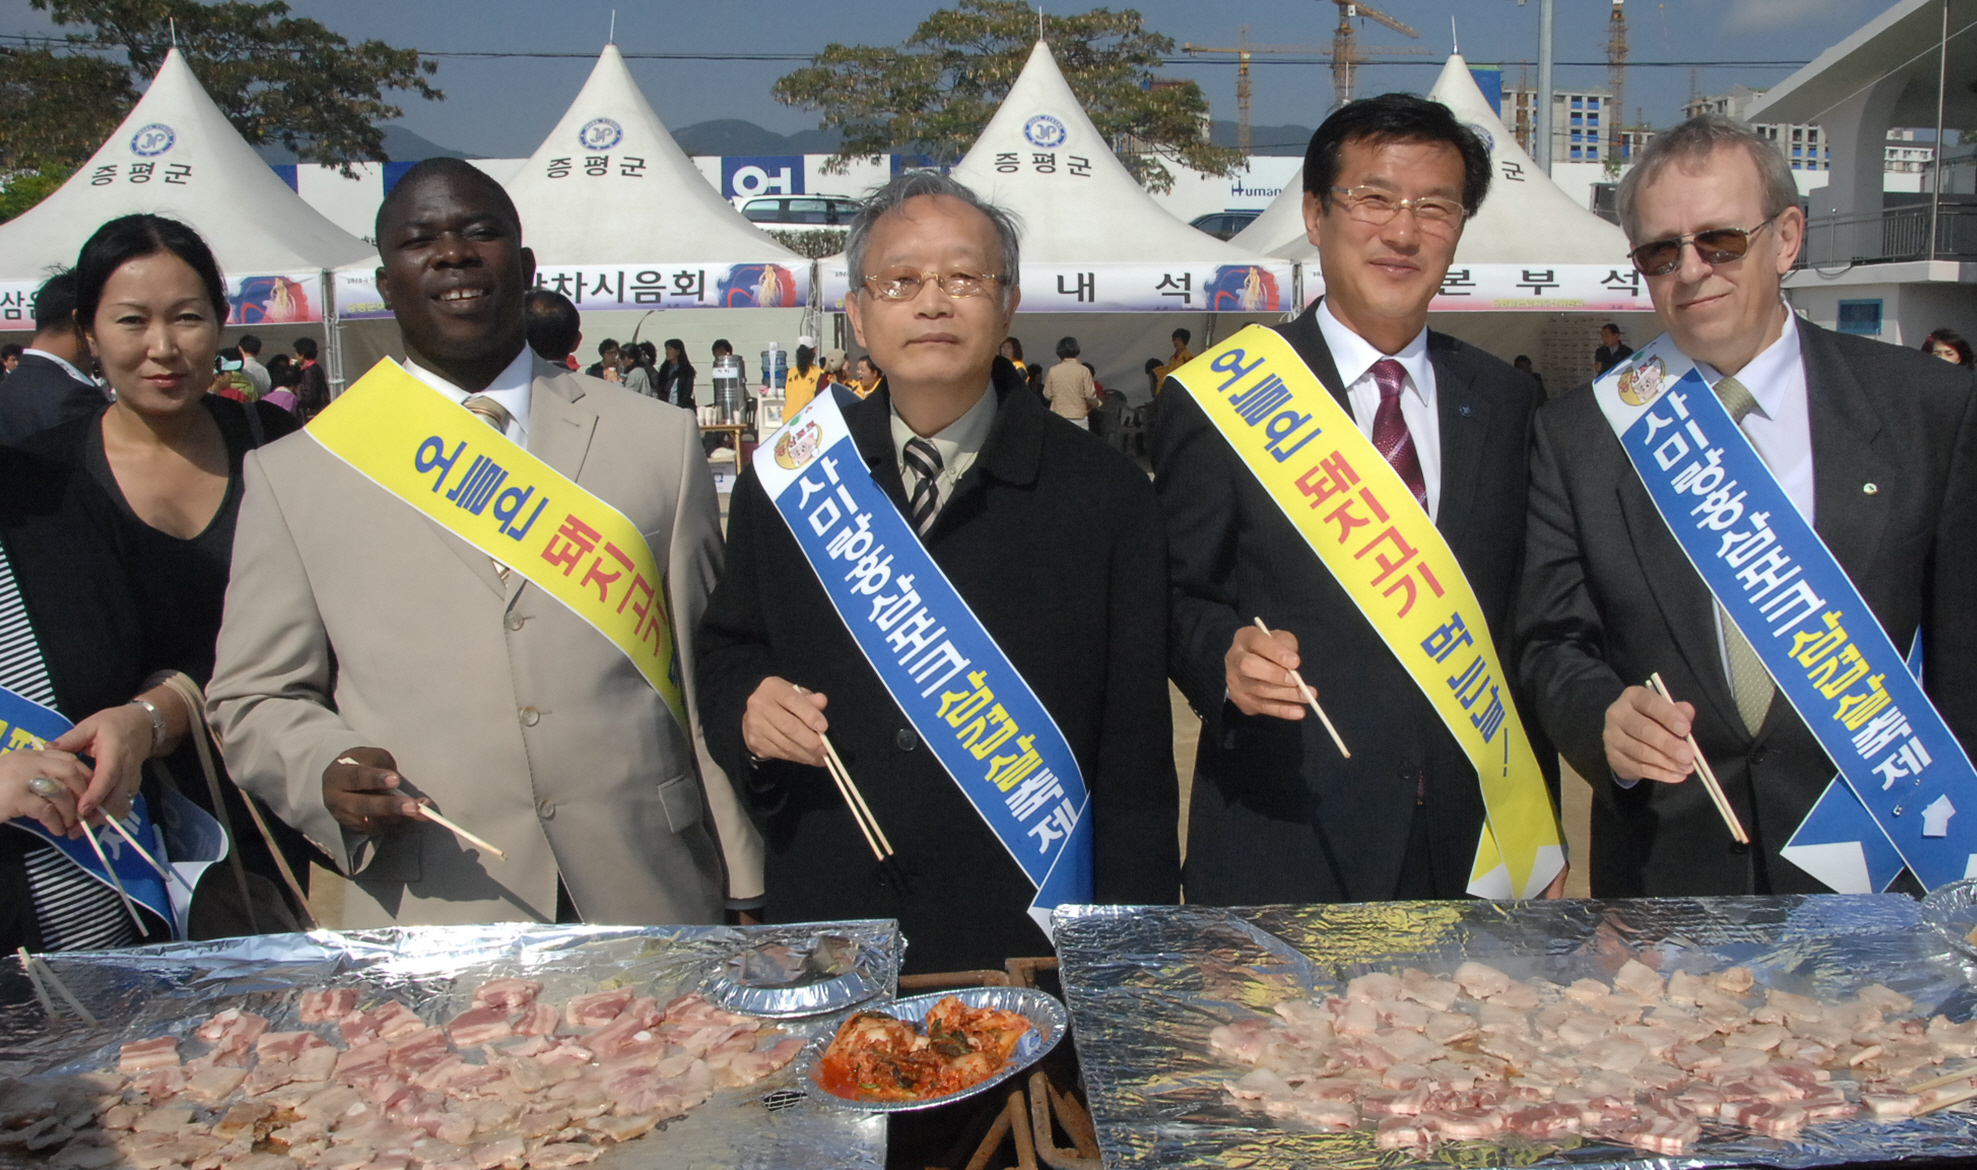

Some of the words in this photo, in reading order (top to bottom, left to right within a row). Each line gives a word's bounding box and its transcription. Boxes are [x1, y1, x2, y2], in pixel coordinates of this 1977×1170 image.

[91, 162, 192, 186] 증평군
[547, 155, 647, 178] 증평군
[994, 152, 1092, 177] 증평군
[414, 436, 549, 541] 오늘은
[1210, 348, 1322, 463] 오늘은
[1294, 449, 1446, 619] 돼지고기
